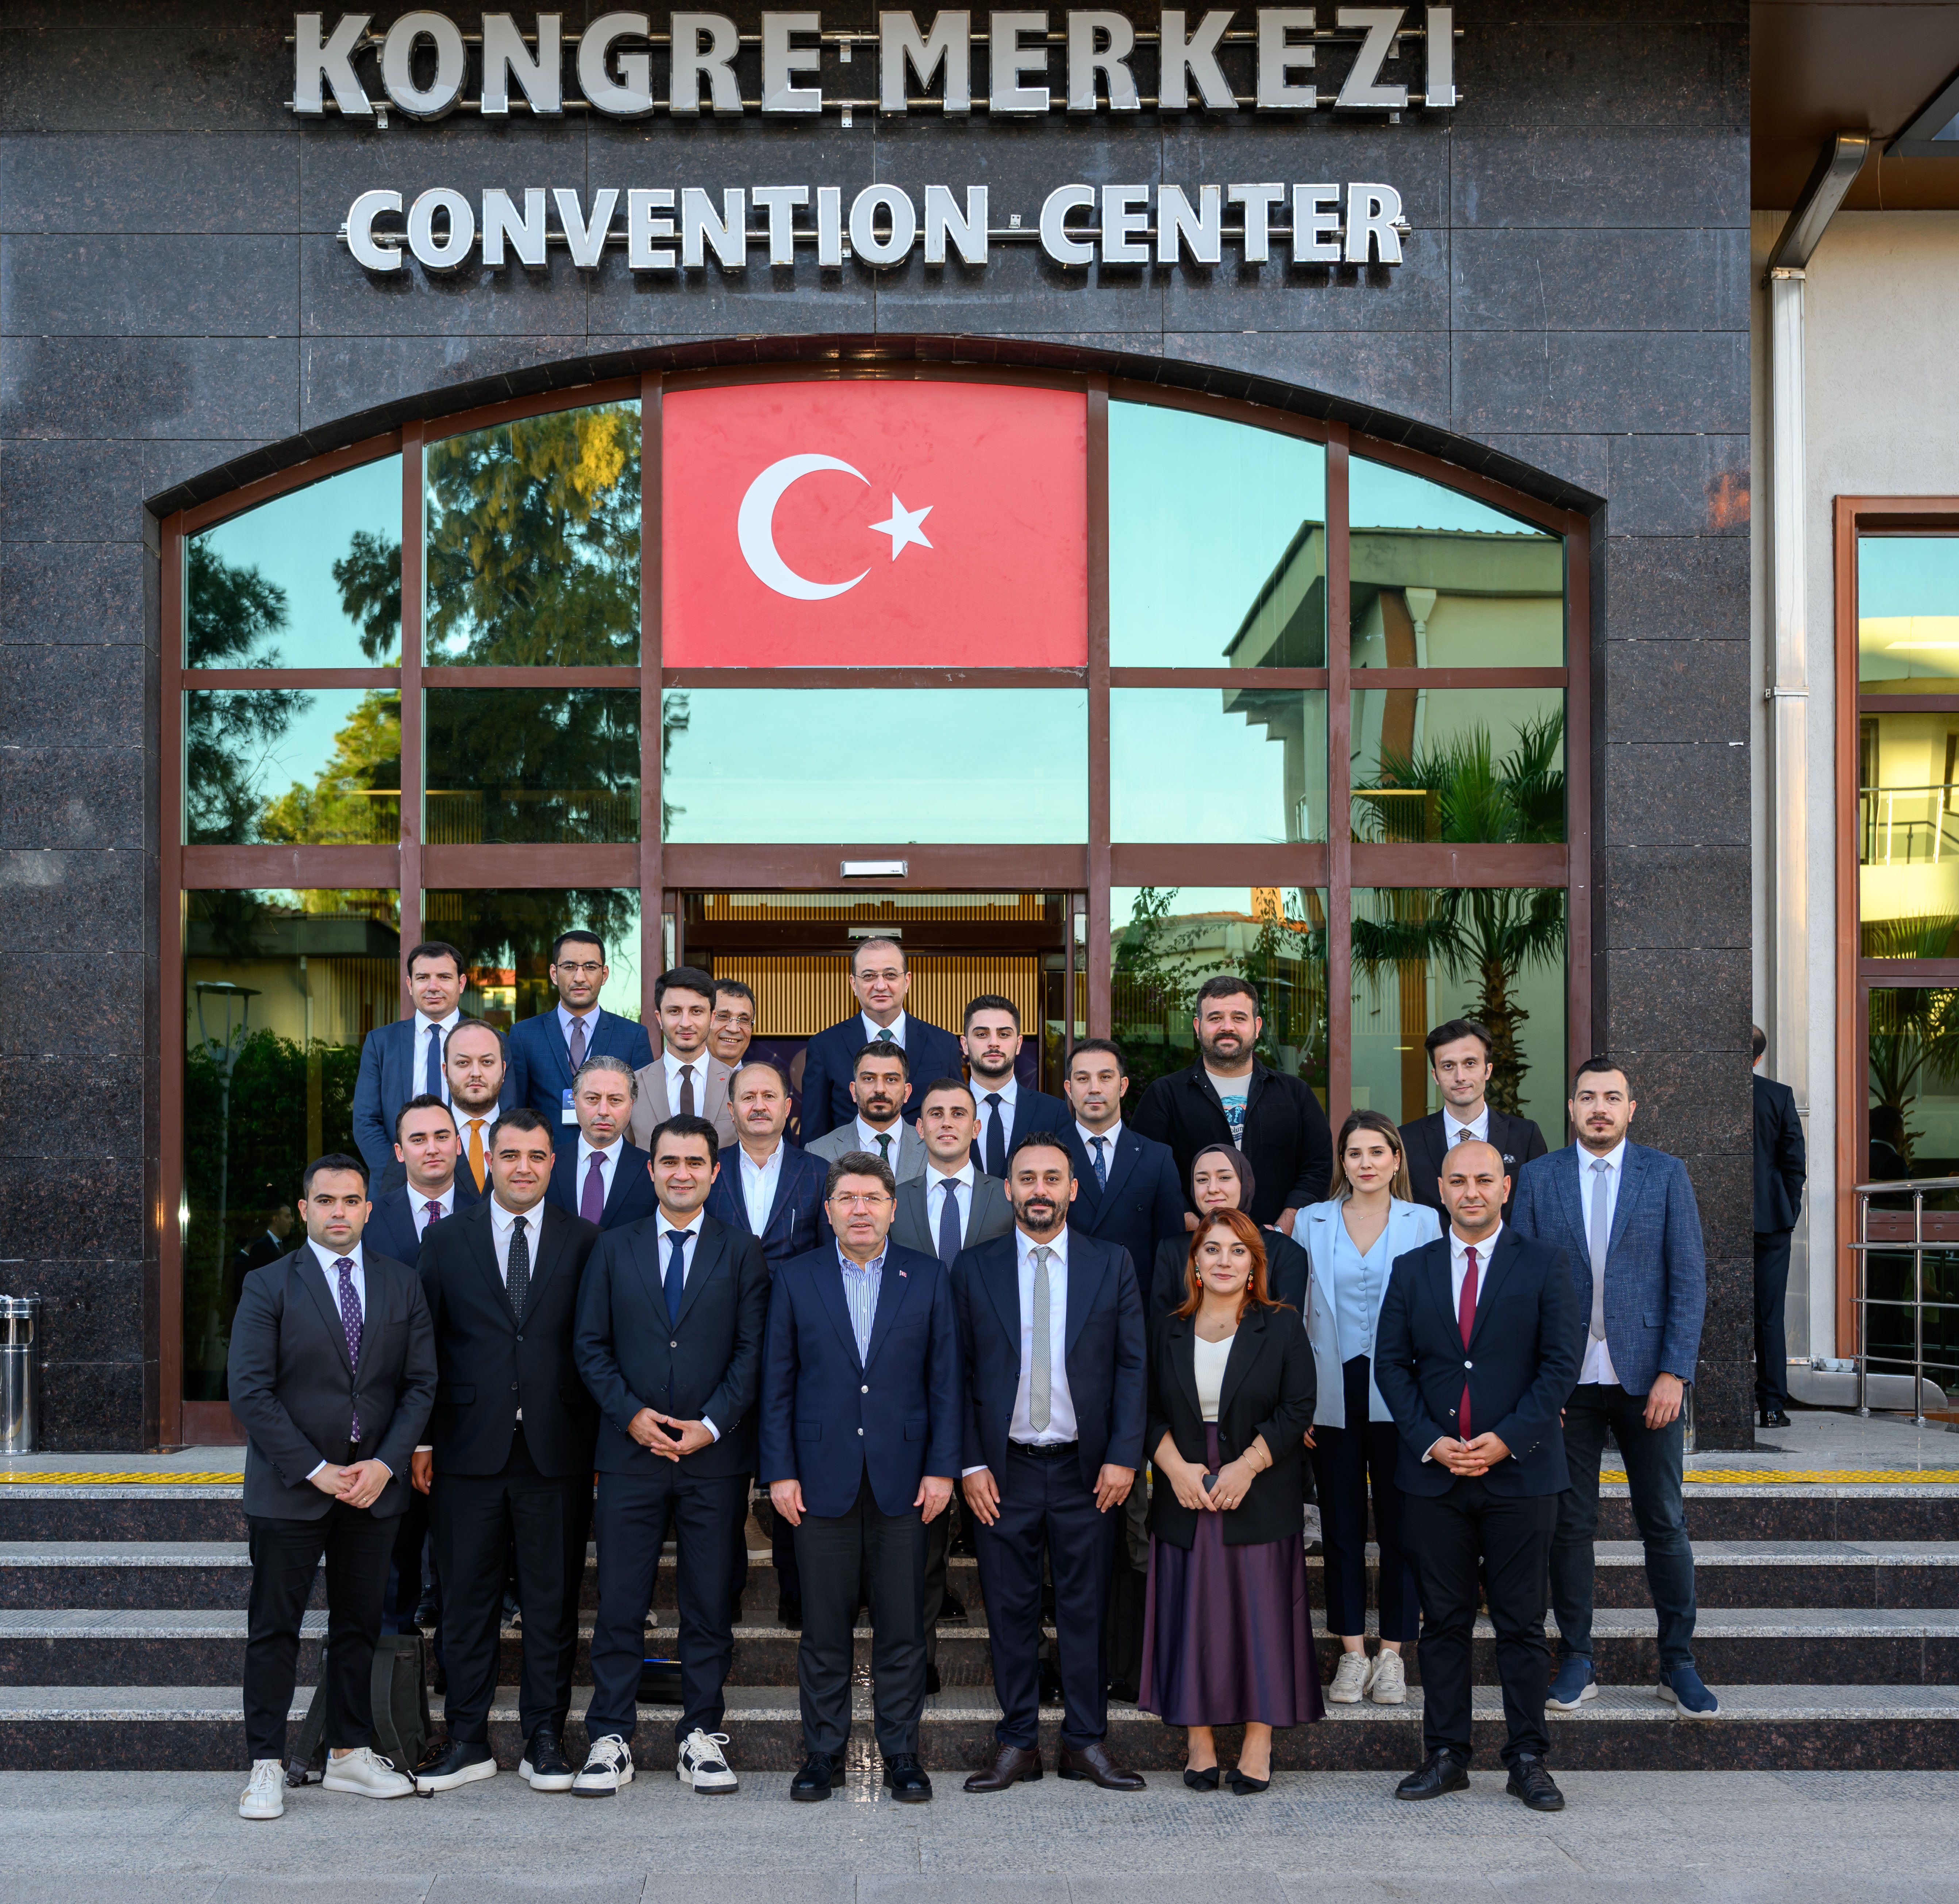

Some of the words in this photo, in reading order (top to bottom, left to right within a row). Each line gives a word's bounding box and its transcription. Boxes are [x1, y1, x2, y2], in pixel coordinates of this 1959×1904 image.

[293, 10, 823, 118] KONGRE
[347, 184, 988, 271] CONVENTION
[1039, 182, 1404, 265] CENTER
